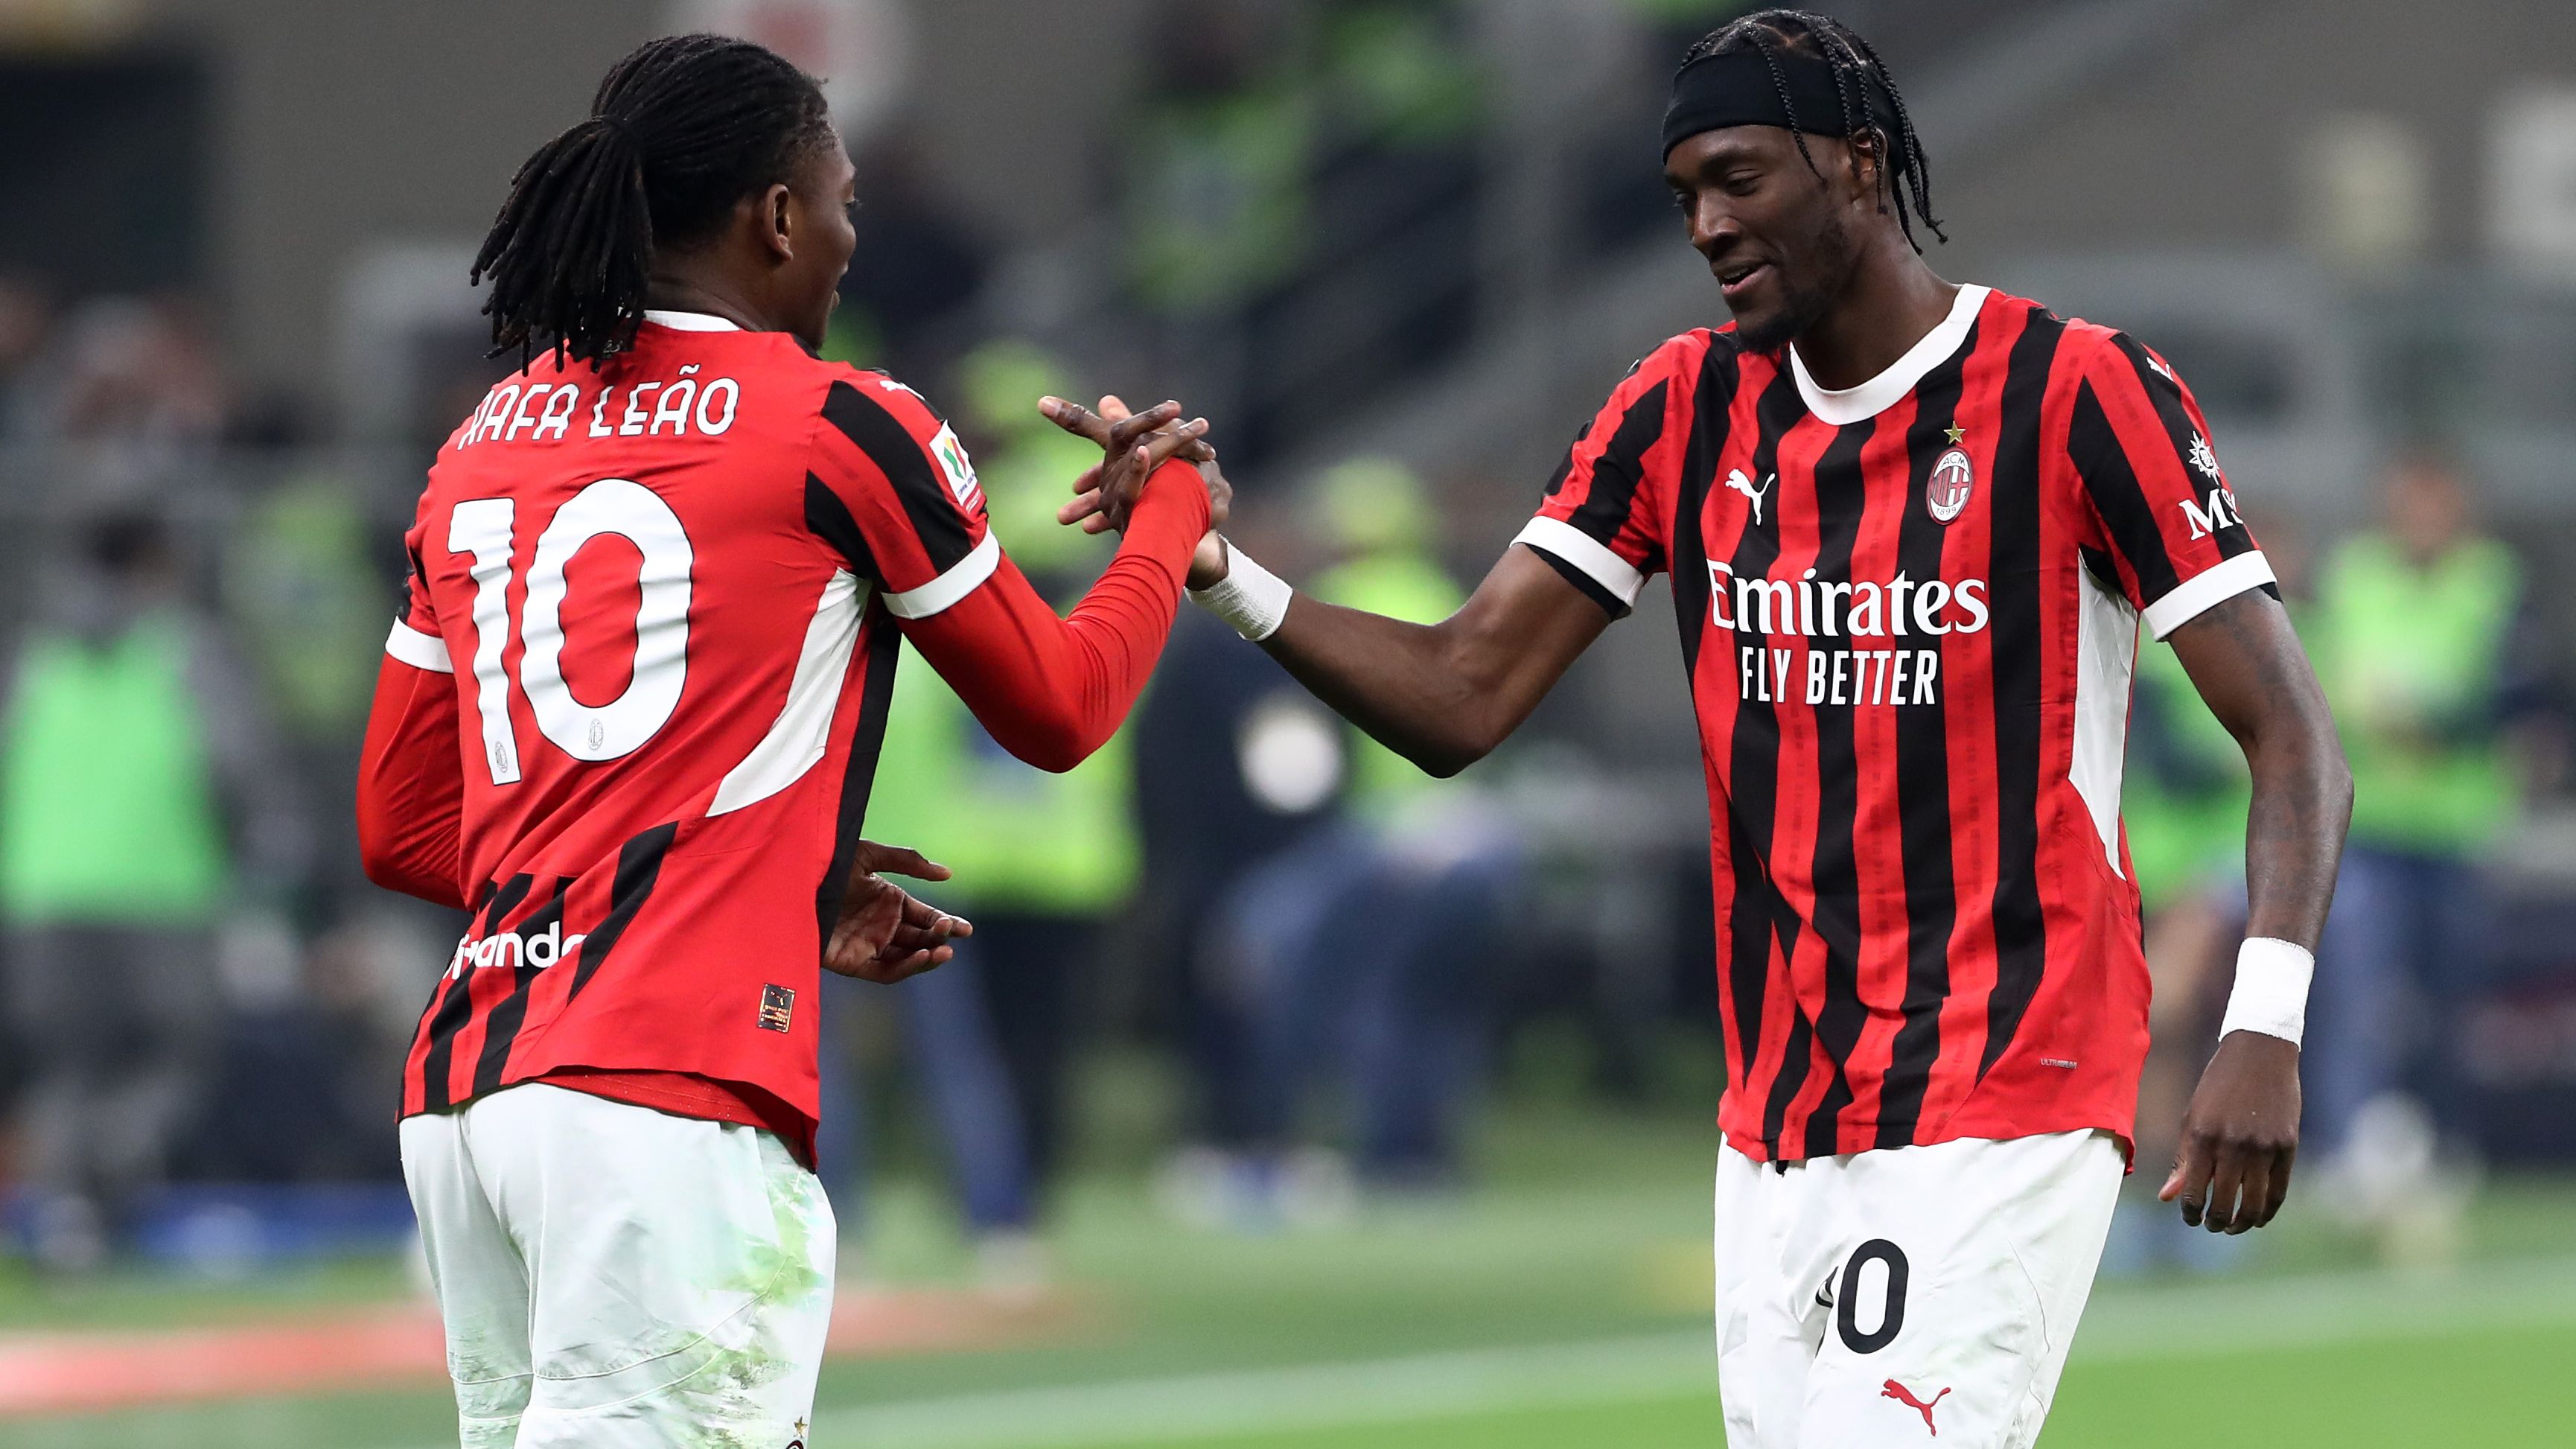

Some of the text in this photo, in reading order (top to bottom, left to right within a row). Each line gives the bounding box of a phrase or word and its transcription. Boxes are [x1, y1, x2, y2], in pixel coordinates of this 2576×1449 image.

[588, 364, 740, 437] LEÃO
[1940, 453, 1966, 468] ACM
[1936, 506, 1957, 515] 1899
[2178, 488, 2244, 541] MS
[1706, 558, 1989, 637] Emirates
[447, 477, 694, 786] 10
[1742, 646, 1937, 705] FLY BETTER
